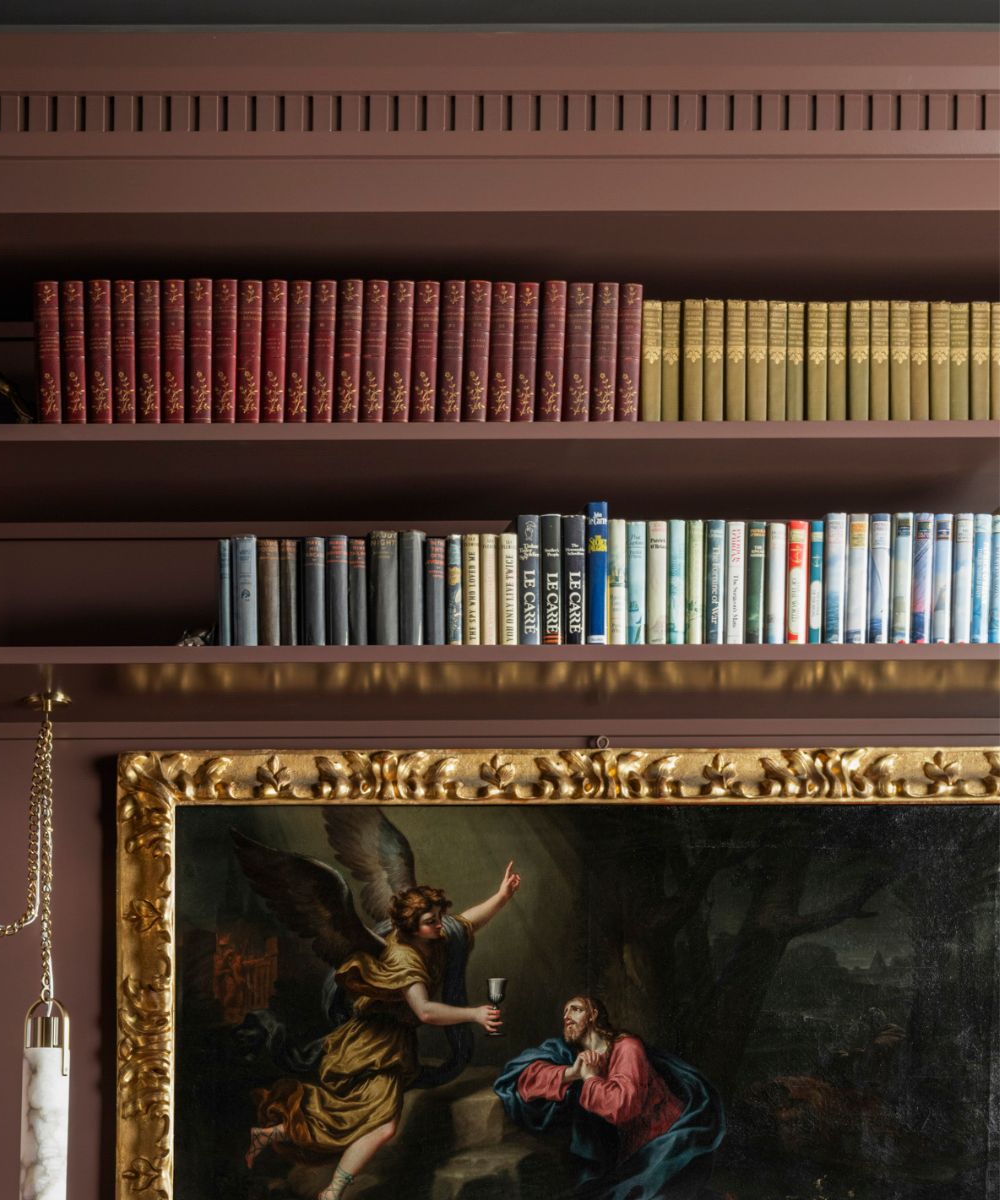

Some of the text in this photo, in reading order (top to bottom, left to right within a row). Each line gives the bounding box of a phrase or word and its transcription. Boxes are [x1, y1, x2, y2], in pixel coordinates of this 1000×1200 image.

[468, 552, 477, 641] THE SPY WHO LOVED ME
[505, 555, 515, 642] YOU ONLY LIVE TWICE
[523, 569, 539, 634] LE CARRÉ
[546, 572, 559, 591] LE
[569, 571, 584, 634] LE CARRÉ
[711, 546, 721, 624] The Fortune of War
